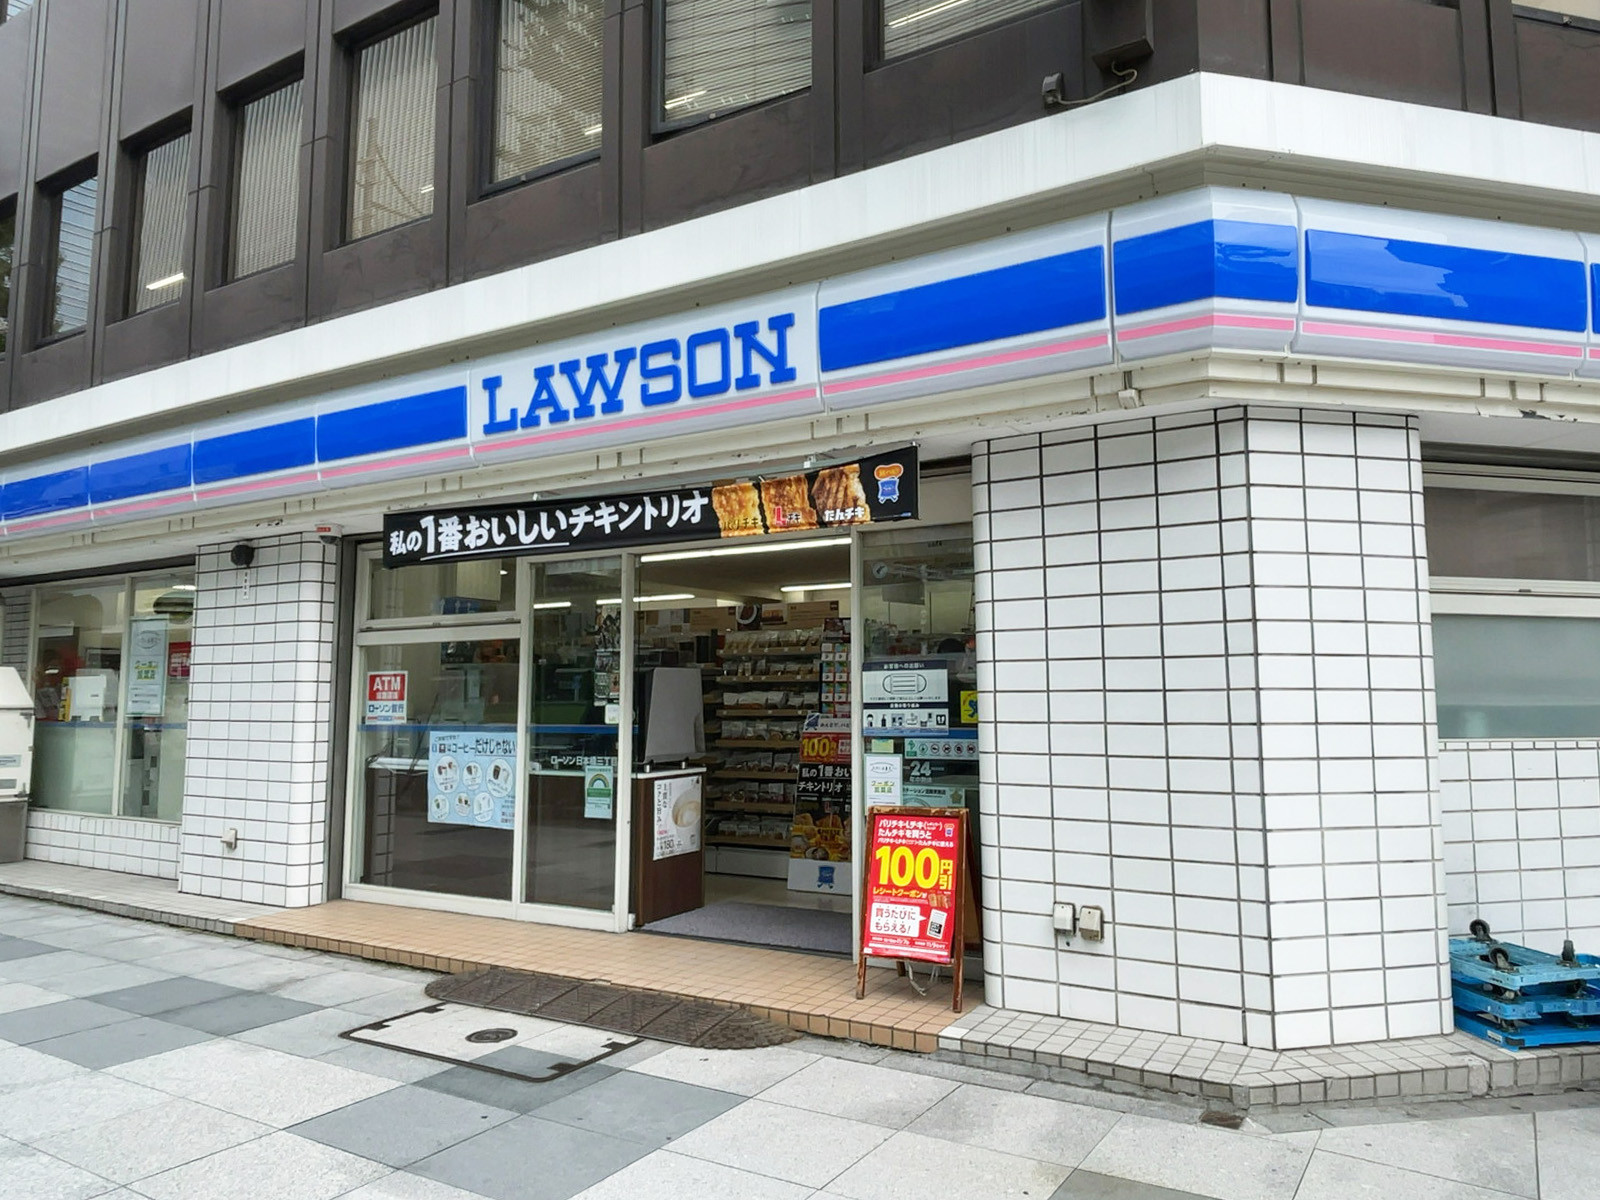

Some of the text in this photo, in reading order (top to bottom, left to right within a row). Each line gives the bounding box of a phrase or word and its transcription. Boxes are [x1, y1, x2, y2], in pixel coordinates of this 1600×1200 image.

[482, 312, 797, 435] LAWSON
[824, 507, 865, 522] たんチキ
[389, 490, 709, 556] 私の1番おいしいチキントリオ
[373, 676, 401, 691] ATM
[910, 761, 932, 776] 24
[798, 781, 843, 793] チキントリオ
[878, 829, 932, 839] たんチキを買うと
[875, 907, 916, 921] 買うたびに
